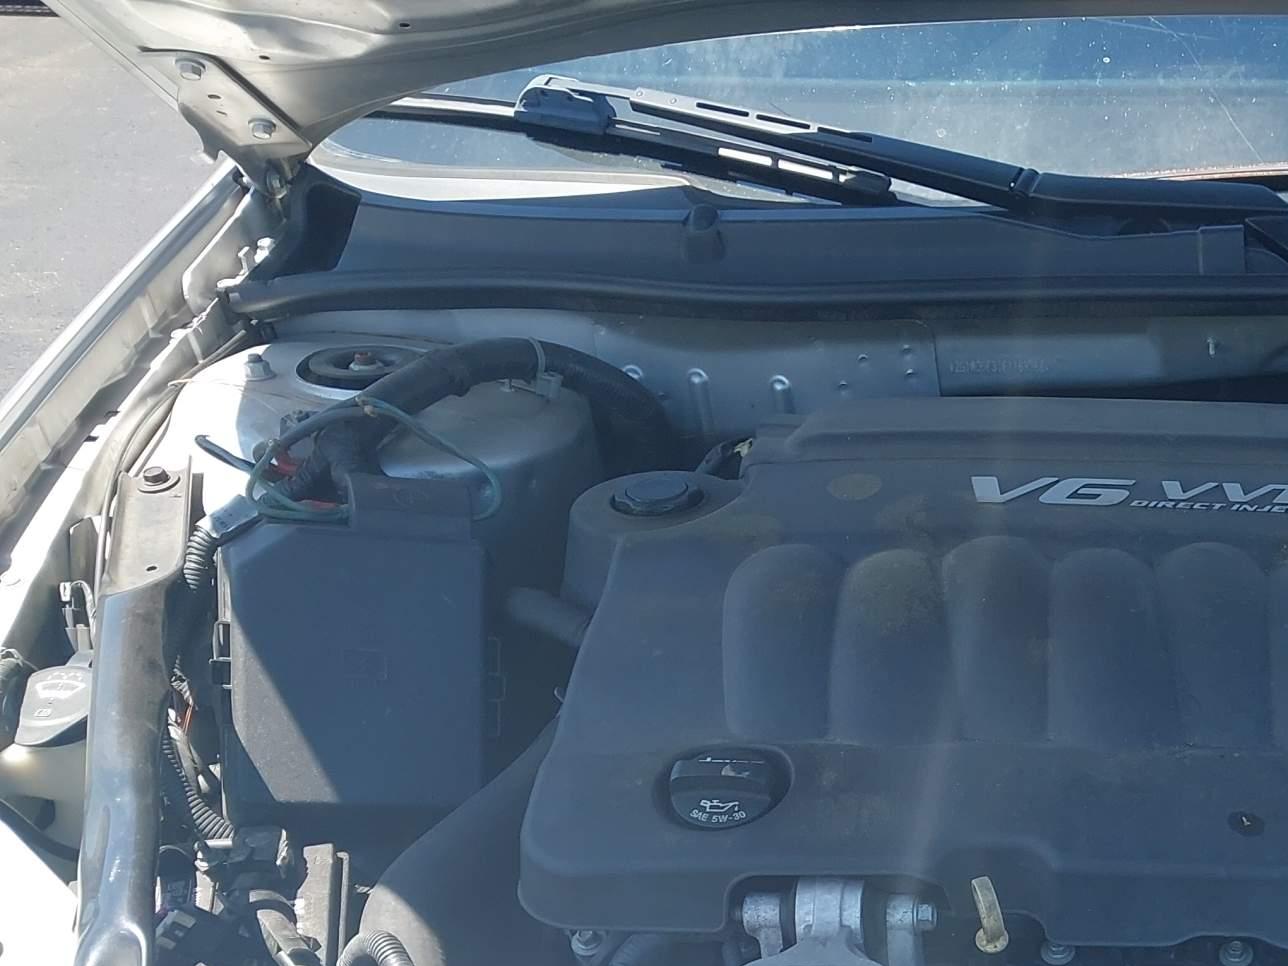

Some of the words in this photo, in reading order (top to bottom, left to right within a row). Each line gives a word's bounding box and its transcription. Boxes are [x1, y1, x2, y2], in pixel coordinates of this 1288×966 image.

[970, 476, 1136, 505] V6
[1129, 499, 1224, 511] DIRECT
[689, 809, 709, 822] SAE
[711, 811, 747, 823] 5W-30
